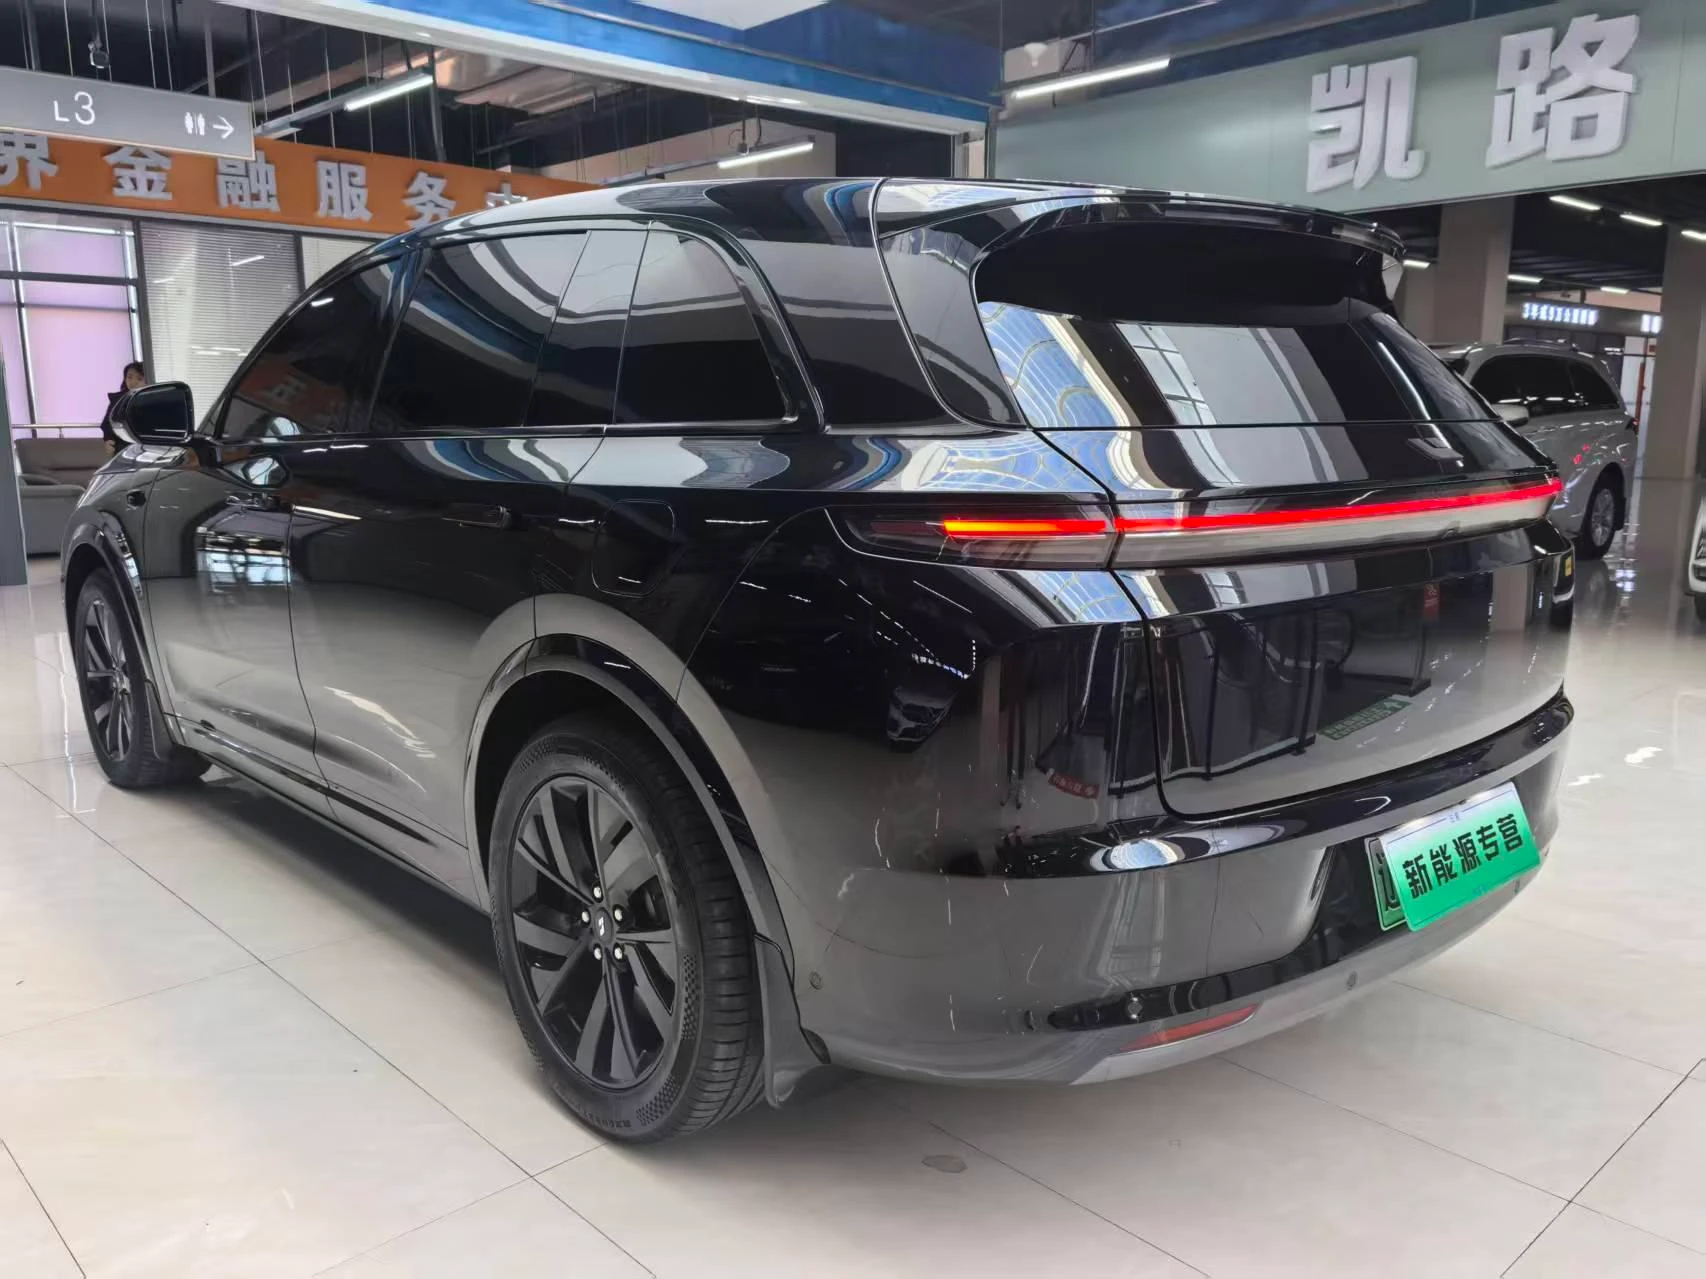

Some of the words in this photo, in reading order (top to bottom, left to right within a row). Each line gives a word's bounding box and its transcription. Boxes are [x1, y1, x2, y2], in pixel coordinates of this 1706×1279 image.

[53, 91, 96, 125] L3
[1306, 15, 1639, 193] 凯路
[1402, 814, 1523, 899] 新能源专营
